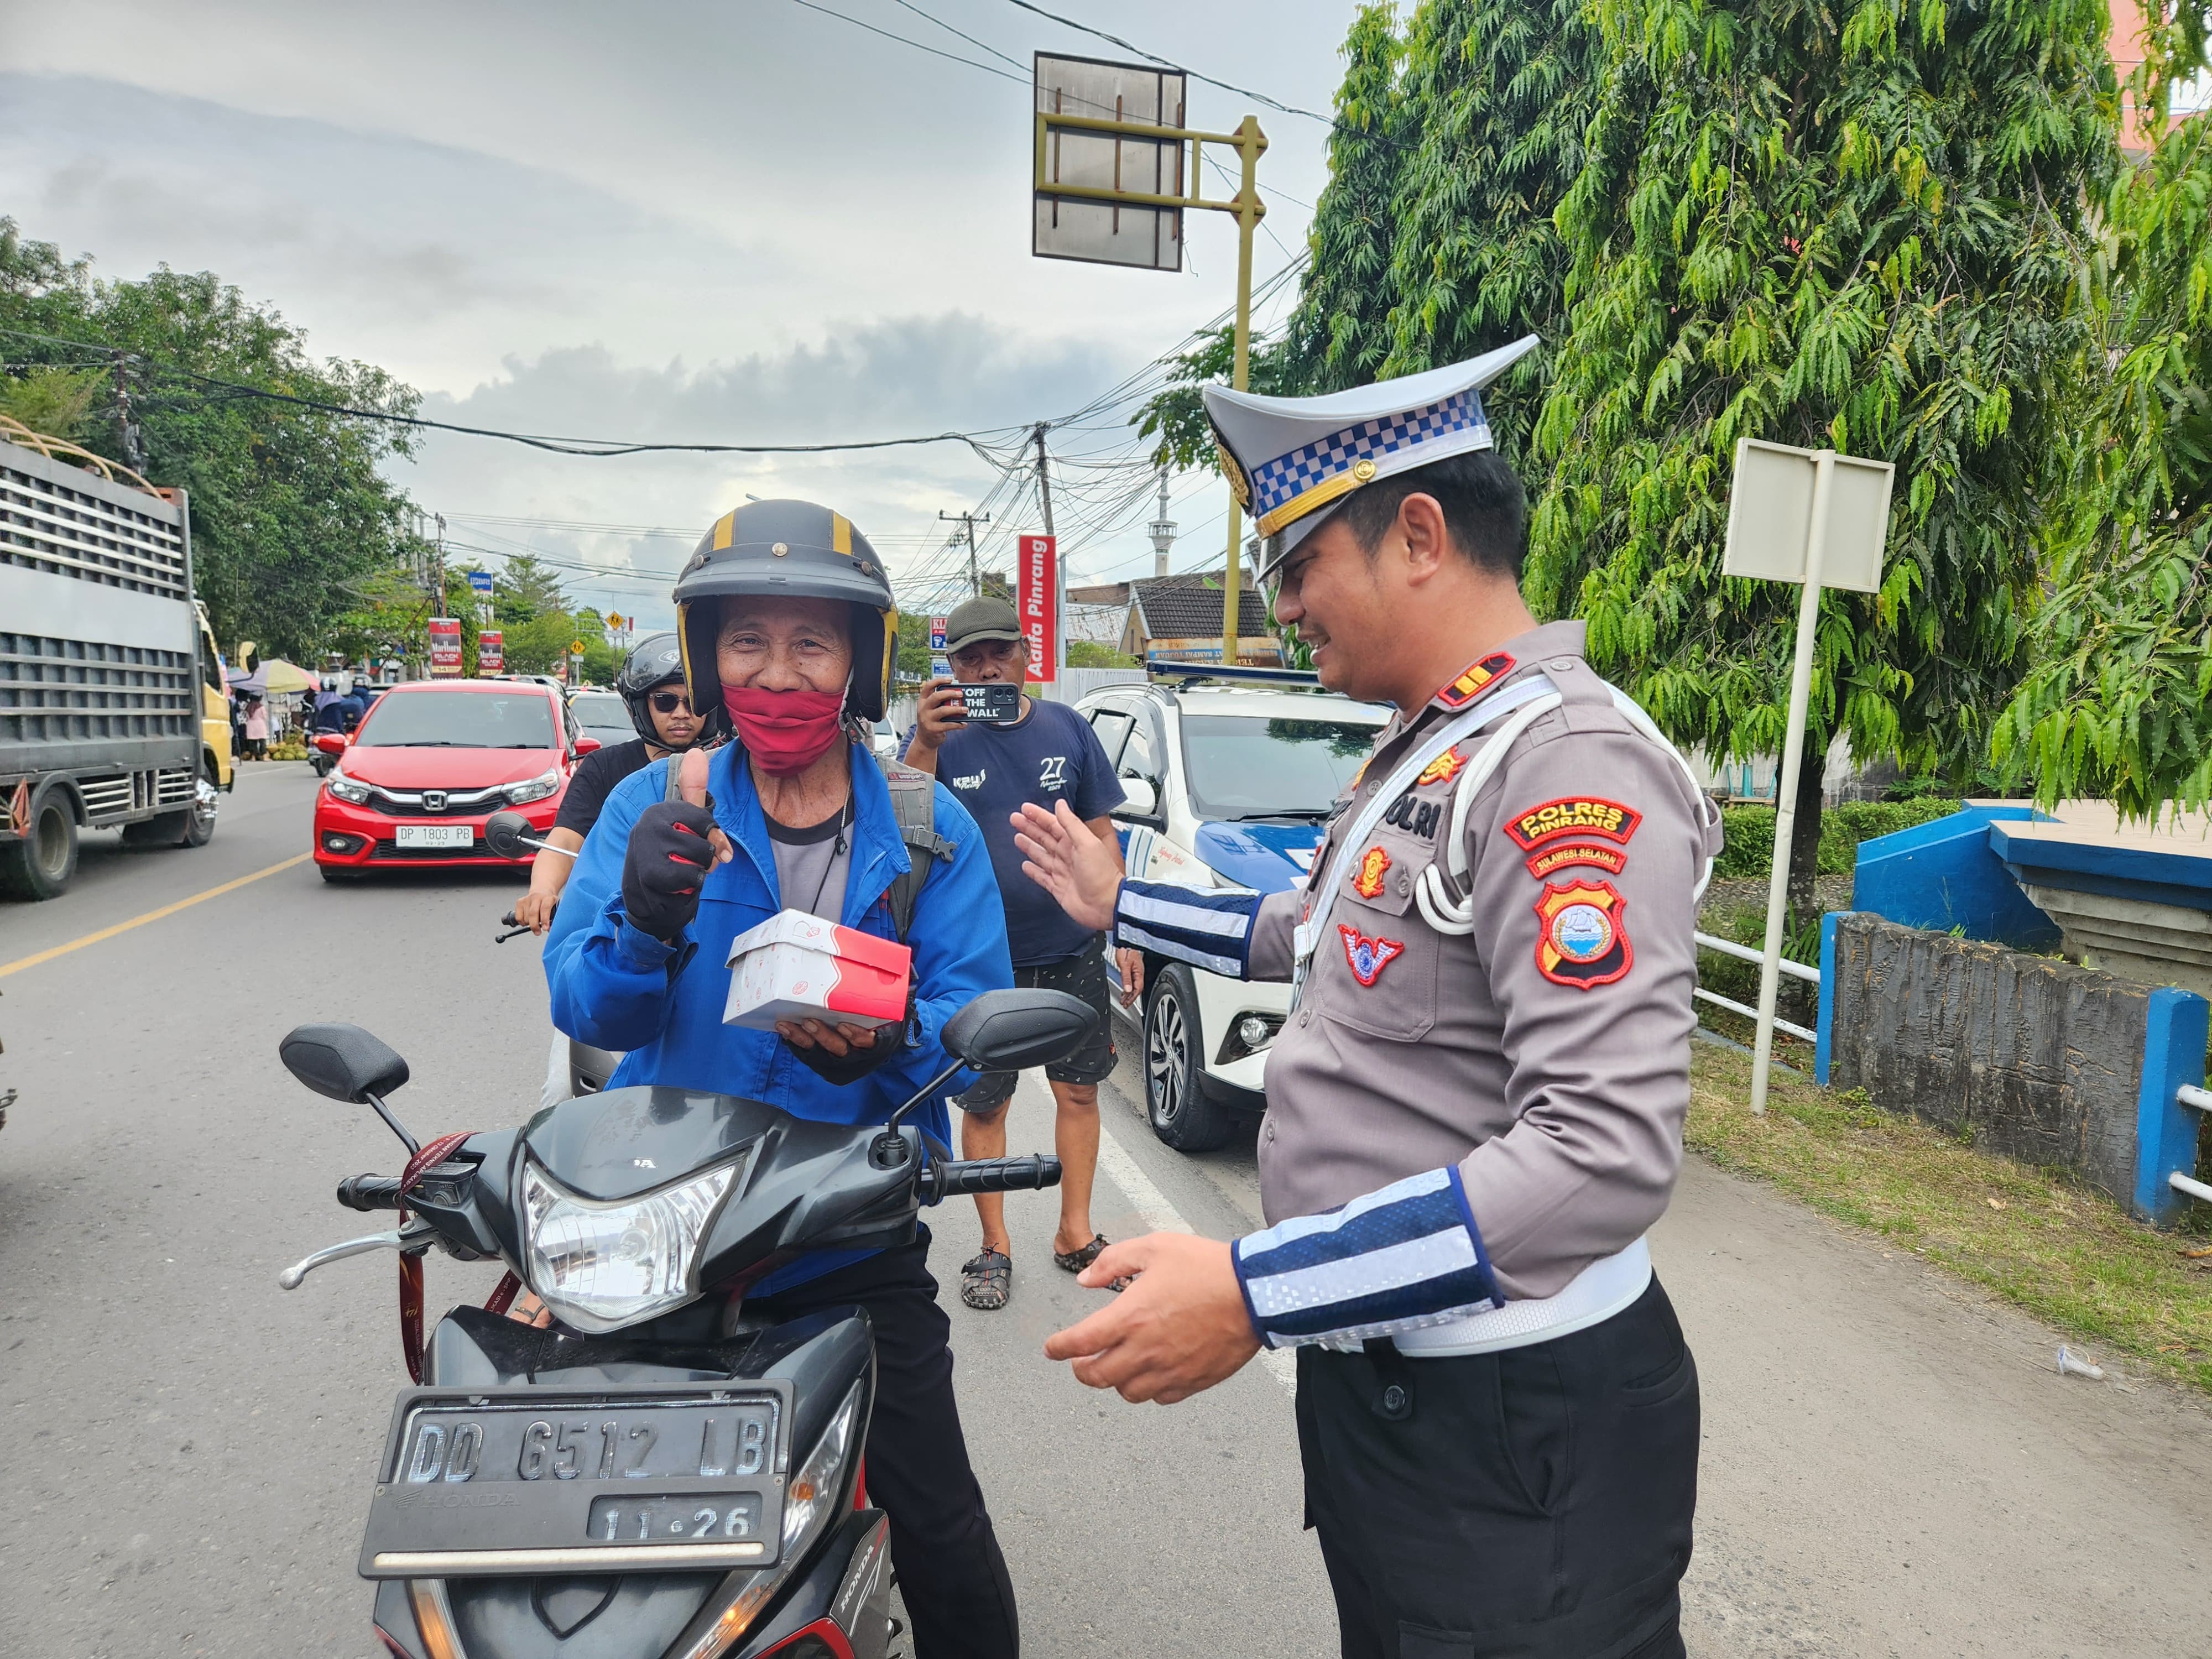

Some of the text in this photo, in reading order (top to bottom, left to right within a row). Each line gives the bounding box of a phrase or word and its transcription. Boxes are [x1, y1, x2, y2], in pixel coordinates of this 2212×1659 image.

[1027, 539, 1047, 617] Pinrang
[966, 698, 985, 707] THE
[1040, 757, 1066, 780] 27
[1385, 795, 1441, 839] OLRI
[1521, 802, 1623, 832] POLRES
[1528, 815, 1618, 839] PINRANG
[401, 828, 469, 839] DP 1803 PB
[1536, 848, 1616, 870] SULAWESI SELATAN
[420, 1145, 439, 1160] Oktober
[425, 1150, 445, 1167] TEKNIS
[410, 1159, 422, 1170] 2023
[406, 1165, 426, 1186] APLIKASI
[489, 1295, 502, 1312] LIKASI
[408, 1417, 766, 1483] DD 6512 LB
[421, 1493, 522, 1509] HONDA
[840, 1545, 874, 1614] HONDA
